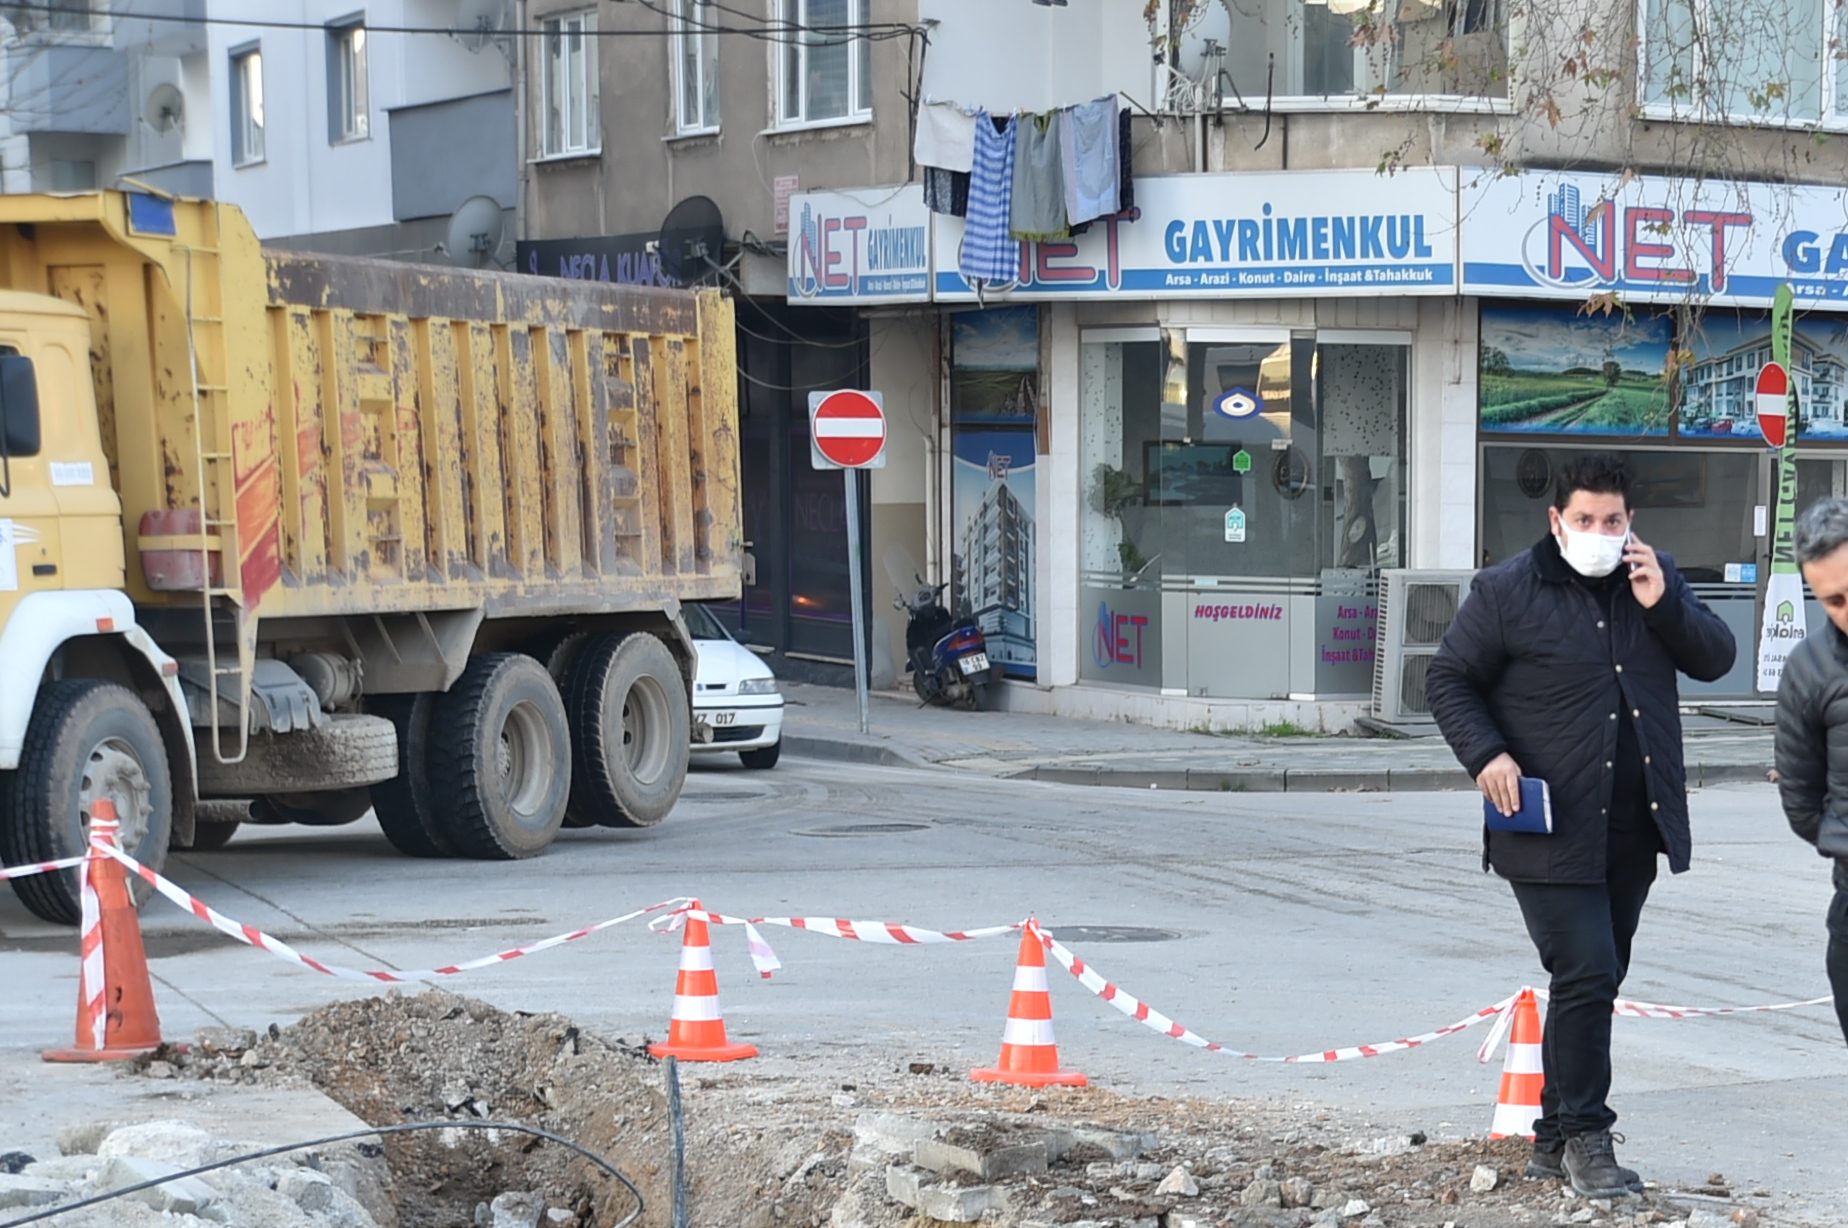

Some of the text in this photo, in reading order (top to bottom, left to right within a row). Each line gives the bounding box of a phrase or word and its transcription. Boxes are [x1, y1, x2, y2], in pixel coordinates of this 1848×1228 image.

[800, 212, 868, 296] NET
[1018, 202, 1433, 288] ET GAYRİMENKUL
[1547, 199, 1752, 292] NET
[1165, 268, 1433, 286] Arsa Arazi Konut Daire İnşaat &Tahakkuk
[1195, 602, 1283, 622] HOŞGELDİNİZ
[1337, 604, 1359, 619] Arsa
[1097, 610, 1149, 670] NET
[1332, 626, 1362, 640] Konut
[1321, 644, 1351, 666] İnşaat
[715, 712, 736, 724] 017
